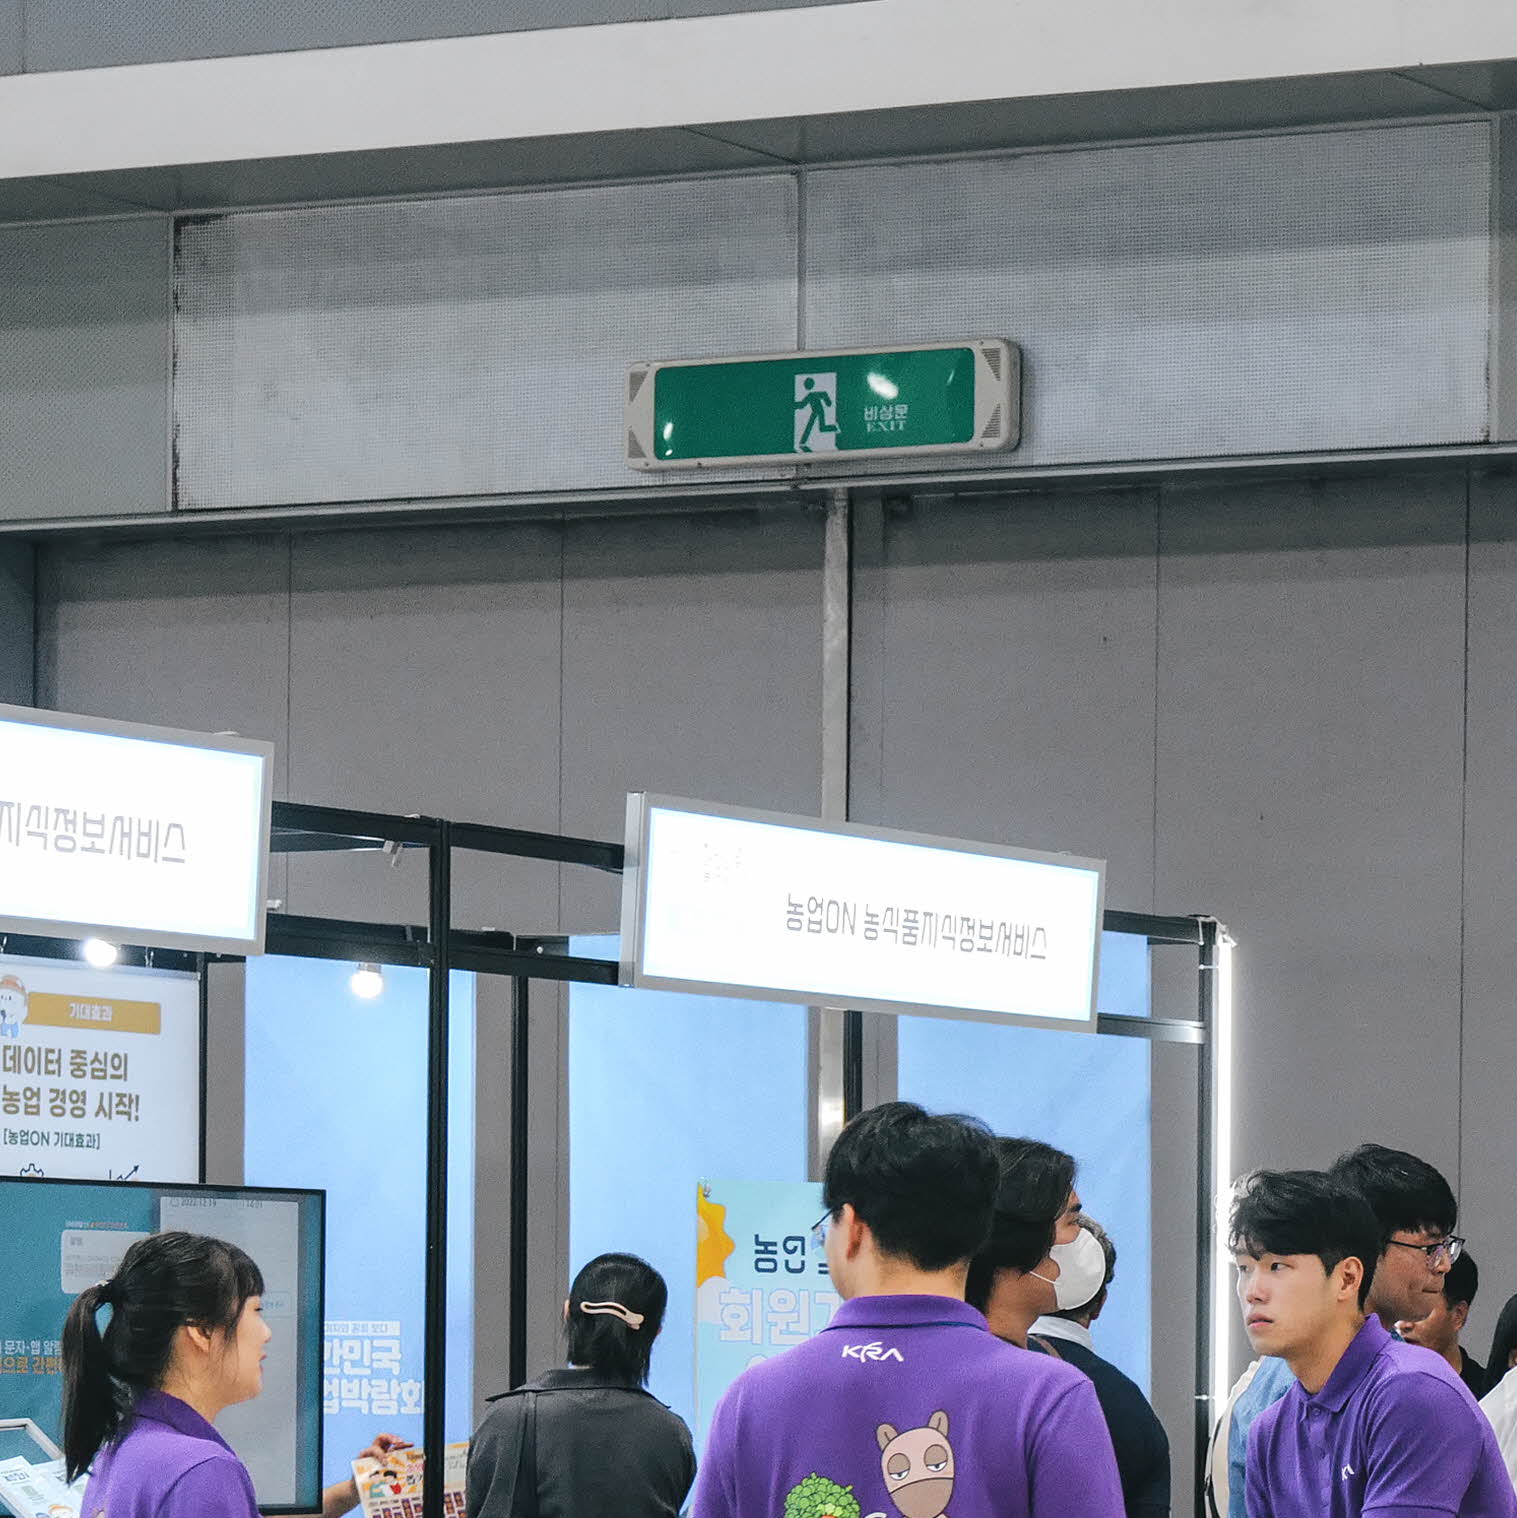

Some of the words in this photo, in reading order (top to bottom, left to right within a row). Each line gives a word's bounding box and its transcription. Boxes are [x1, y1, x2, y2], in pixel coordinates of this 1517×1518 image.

[864, 404, 908, 421] 비상문
[866, 420, 907, 432] EXIT
[786, 893, 856, 936] 농업ON
[863, 903, 1048, 959] 농식품지식정보서비스
[1, 1044, 63, 1077] 데이터
[69, 1048, 129, 1082] 중심의
[1, 1084, 42, 1116] 농업
[48, 1087, 87, 1119] 경영
[94, 1090, 141, 1122] 시작!
[3, 1127, 51, 1147] [농업ON
[53, 1131, 101, 1150] 기대효과]
[841, 1341, 905, 1364] KRA
